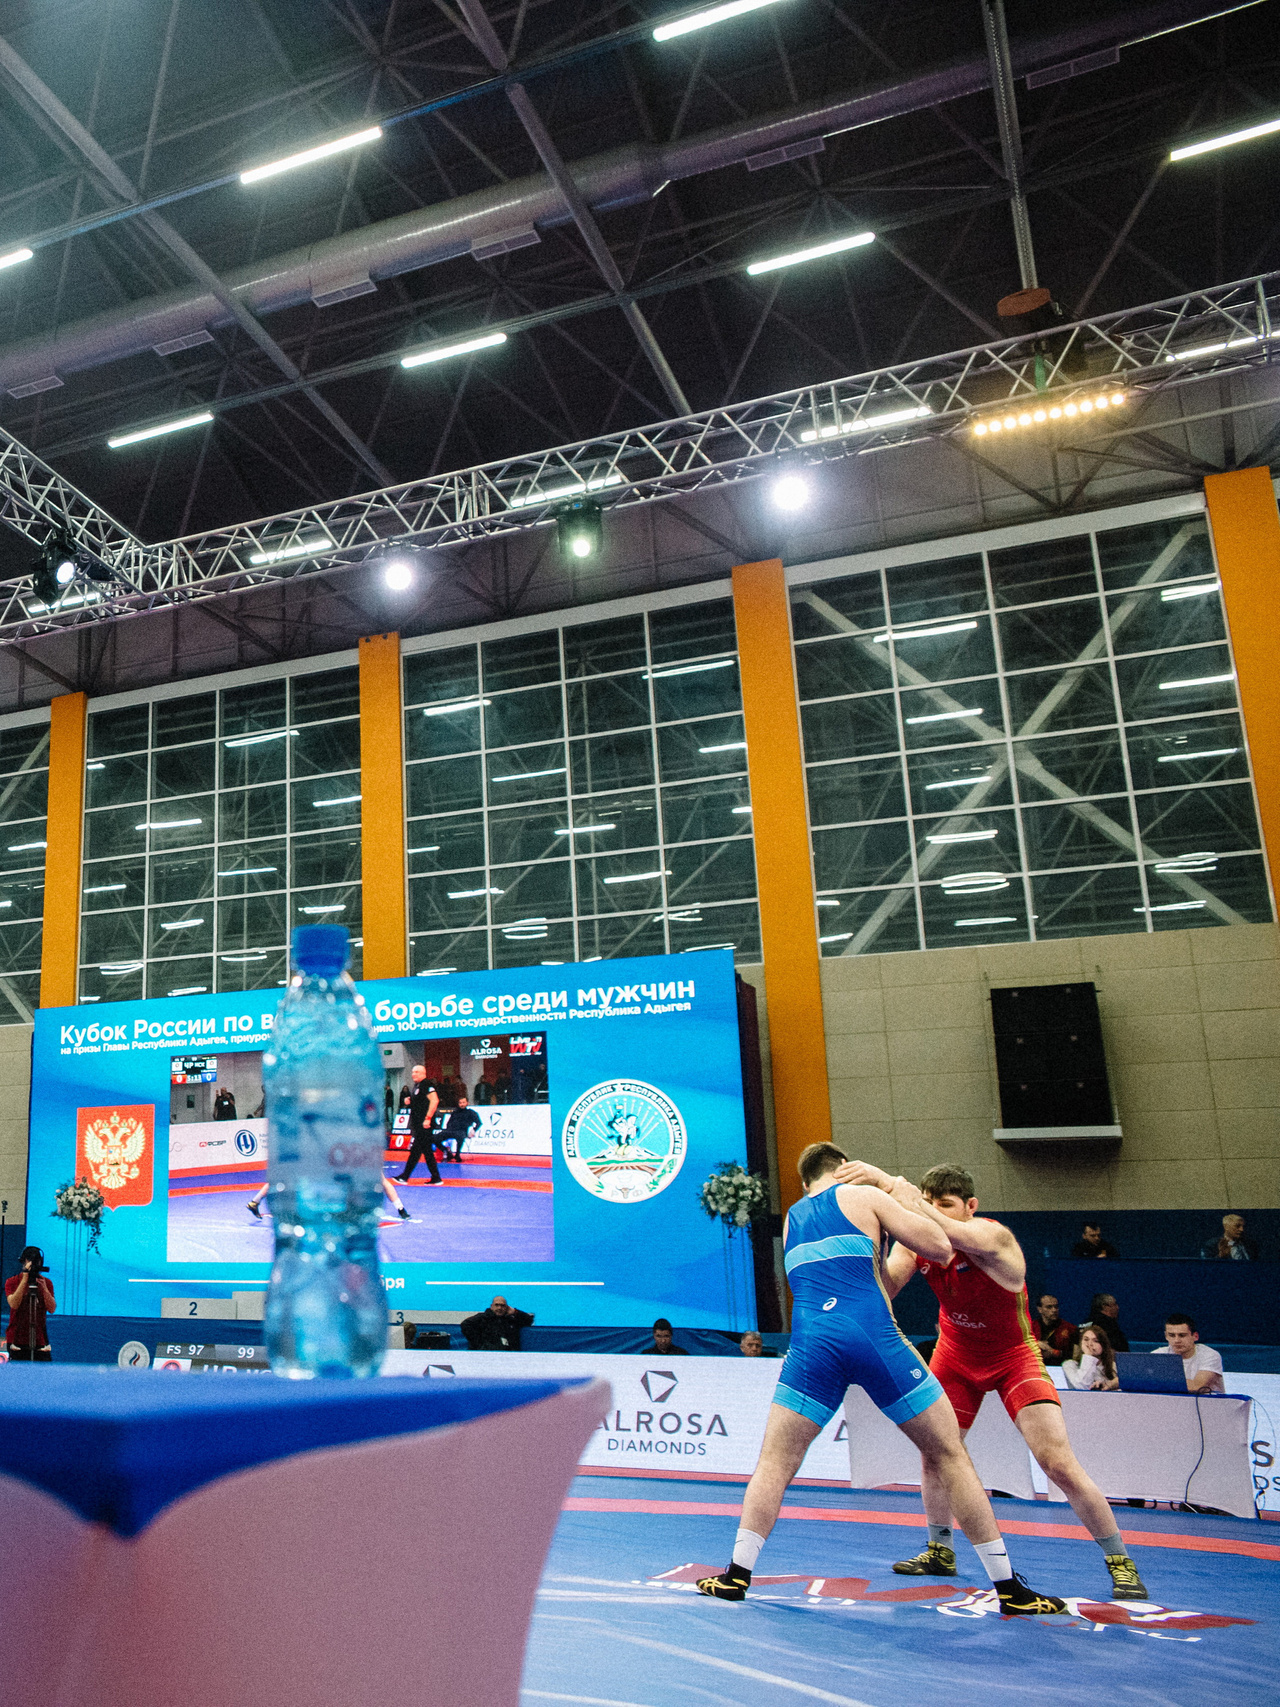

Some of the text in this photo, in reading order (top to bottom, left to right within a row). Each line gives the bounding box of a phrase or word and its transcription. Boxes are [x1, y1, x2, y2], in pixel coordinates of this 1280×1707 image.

[60, 1022, 127, 1047] Кубок
[133, 1019, 216, 1039] России
[223, 1015, 254, 1033] по
[374, 994, 474, 1023] борьбе
[482, 990, 568, 1017] среди
[577, 980, 696, 1009] мужчин
[60, 1047, 72, 1055] на
[73, 1045, 101, 1055] призы
[103, 1042, 130, 1052] Главы
[132, 1039, 188, 1050] Республики
[189, 1036, 229, 1047] Адыгея,
[397, 1020, 453, 1031] 100-летия
[455, 1011, 567, 1028] государственности
[569, 1006, 641, 1019] Республика
[644, 1002, 692, 1014] Адыгея
[470, 1047, 502, 1056] ALROSA
[477, 1130, 514, 1139] LROSA
[189, 1301, 198, 1316] 2
[396, 1311, 405, 1326] 3
[166, 1345, 255, 1358] FS 97 99
[607, 1438, 707, 1456] DIAMONDS
